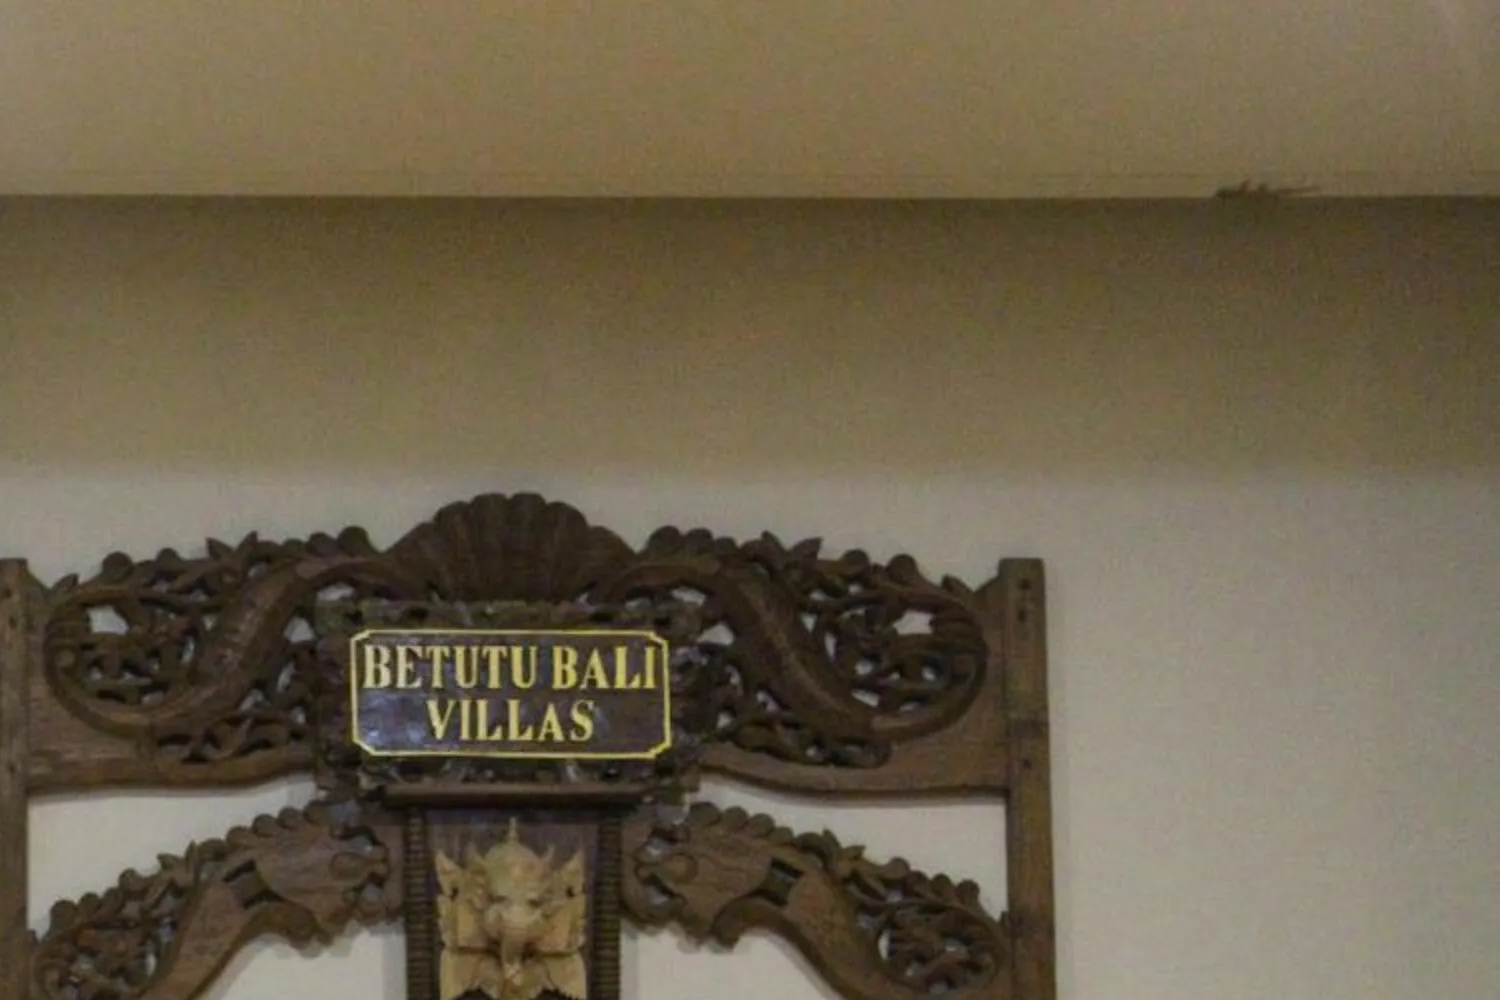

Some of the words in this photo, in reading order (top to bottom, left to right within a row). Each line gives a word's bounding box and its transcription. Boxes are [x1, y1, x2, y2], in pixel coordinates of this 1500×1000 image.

[362, 644, 538, 690] BETUTU
[551, 646, 657, 691] BALI
[426, 699, 596, 742] VILLAS
